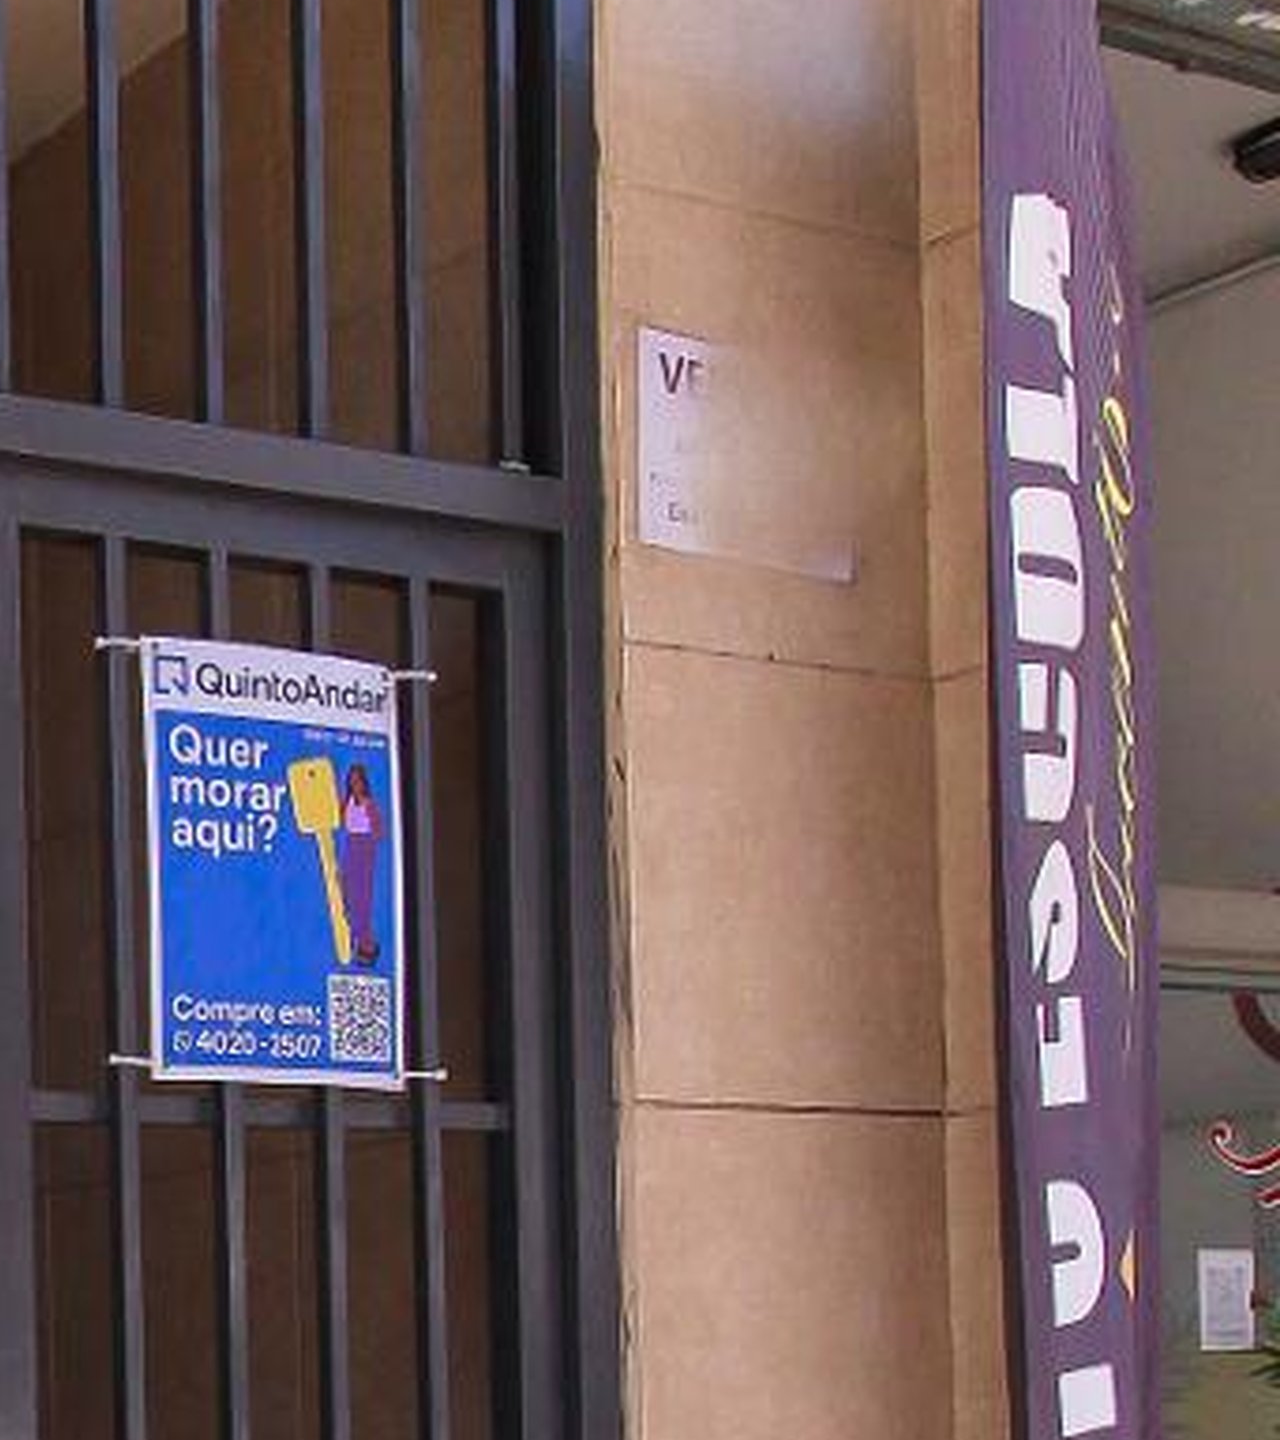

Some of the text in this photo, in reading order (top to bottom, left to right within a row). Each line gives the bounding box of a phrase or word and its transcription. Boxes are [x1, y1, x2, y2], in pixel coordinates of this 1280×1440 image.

[196, 662, 387, 713] QuintoAndar
[169, 723, 269, 770] Quer
[171, 774, 286, 812] morar
[172, 813, 278, 859] aqui?
[172, 993, 276, 1028] Compre
